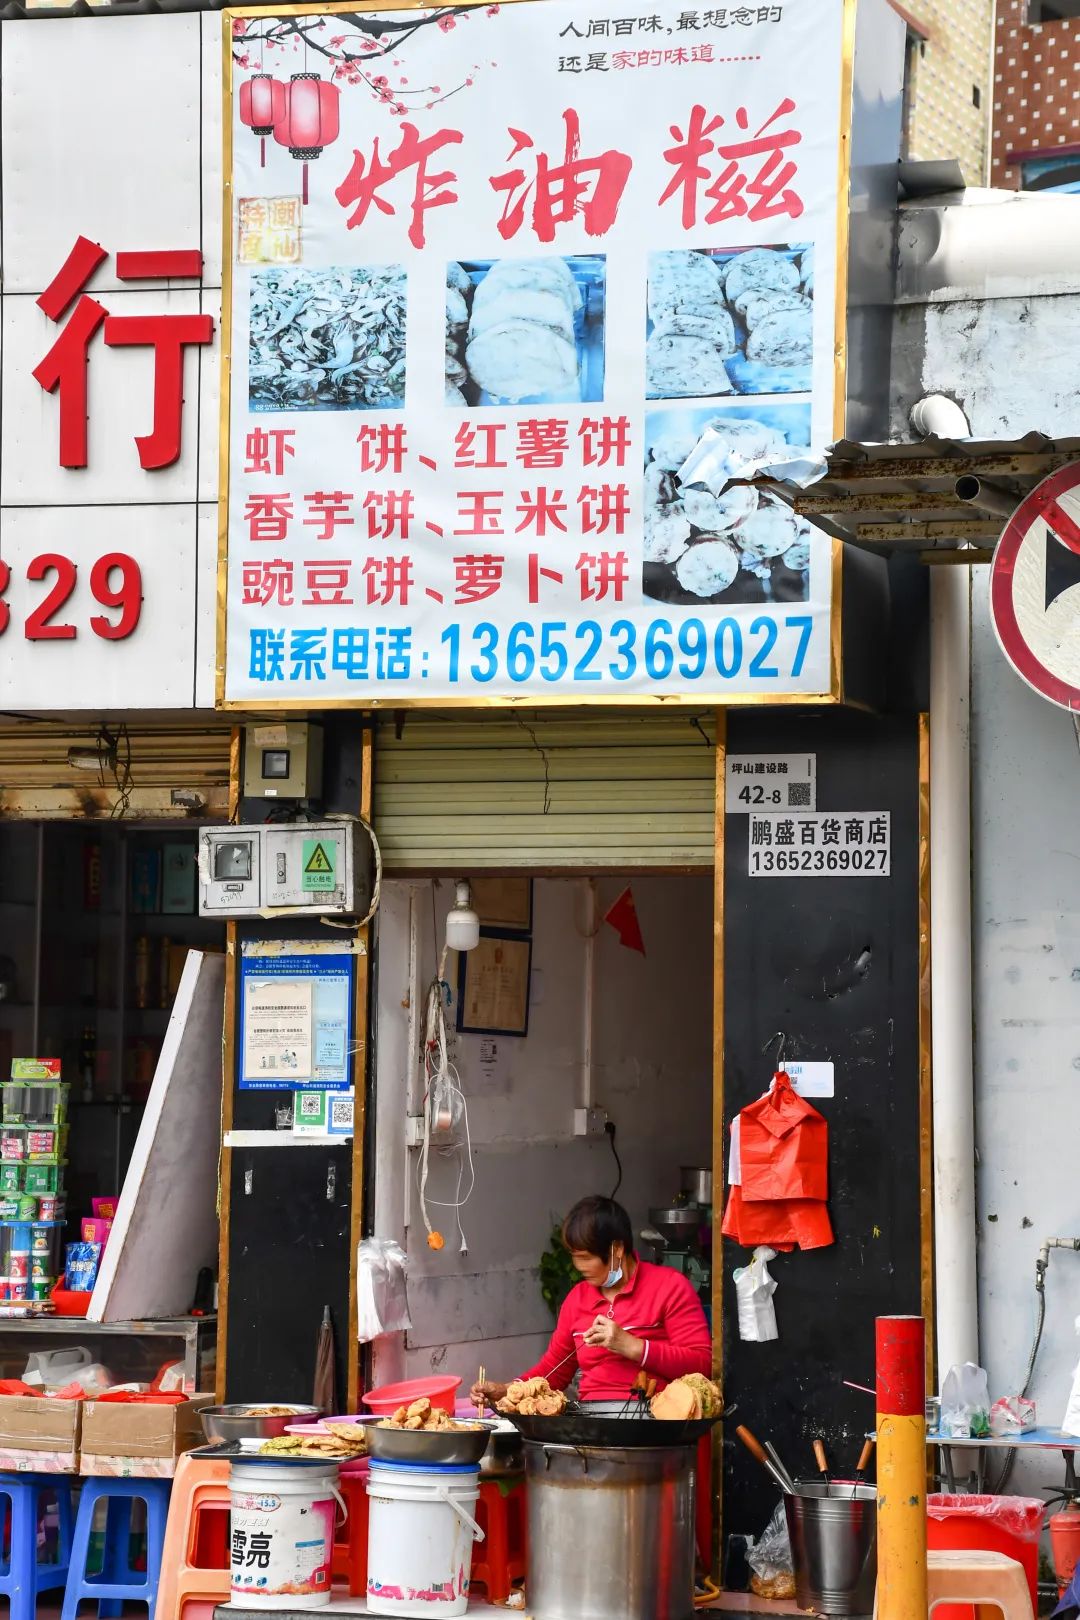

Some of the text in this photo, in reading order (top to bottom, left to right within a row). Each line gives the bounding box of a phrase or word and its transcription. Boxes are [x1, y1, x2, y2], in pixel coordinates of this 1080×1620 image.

[559, 5, 783, 38] 人间百味,最想念的
[334, 98, 804, 249] 炸油糍
[31, 235, 214, 470] 行
[242, 483, 631, 541] 香芋饼、玉米饼
[0, 552, 143, 640] 29
[241, 551, 631, 607] 豌豆饼、萝卜饼
[731, 763, 788, 774] 坪山建设路
[738, 785, 782, 804] 42-8
[752, 817, 887, 846] 鹏盛百货商店
[752, 850, 887, 870] 13652369027
